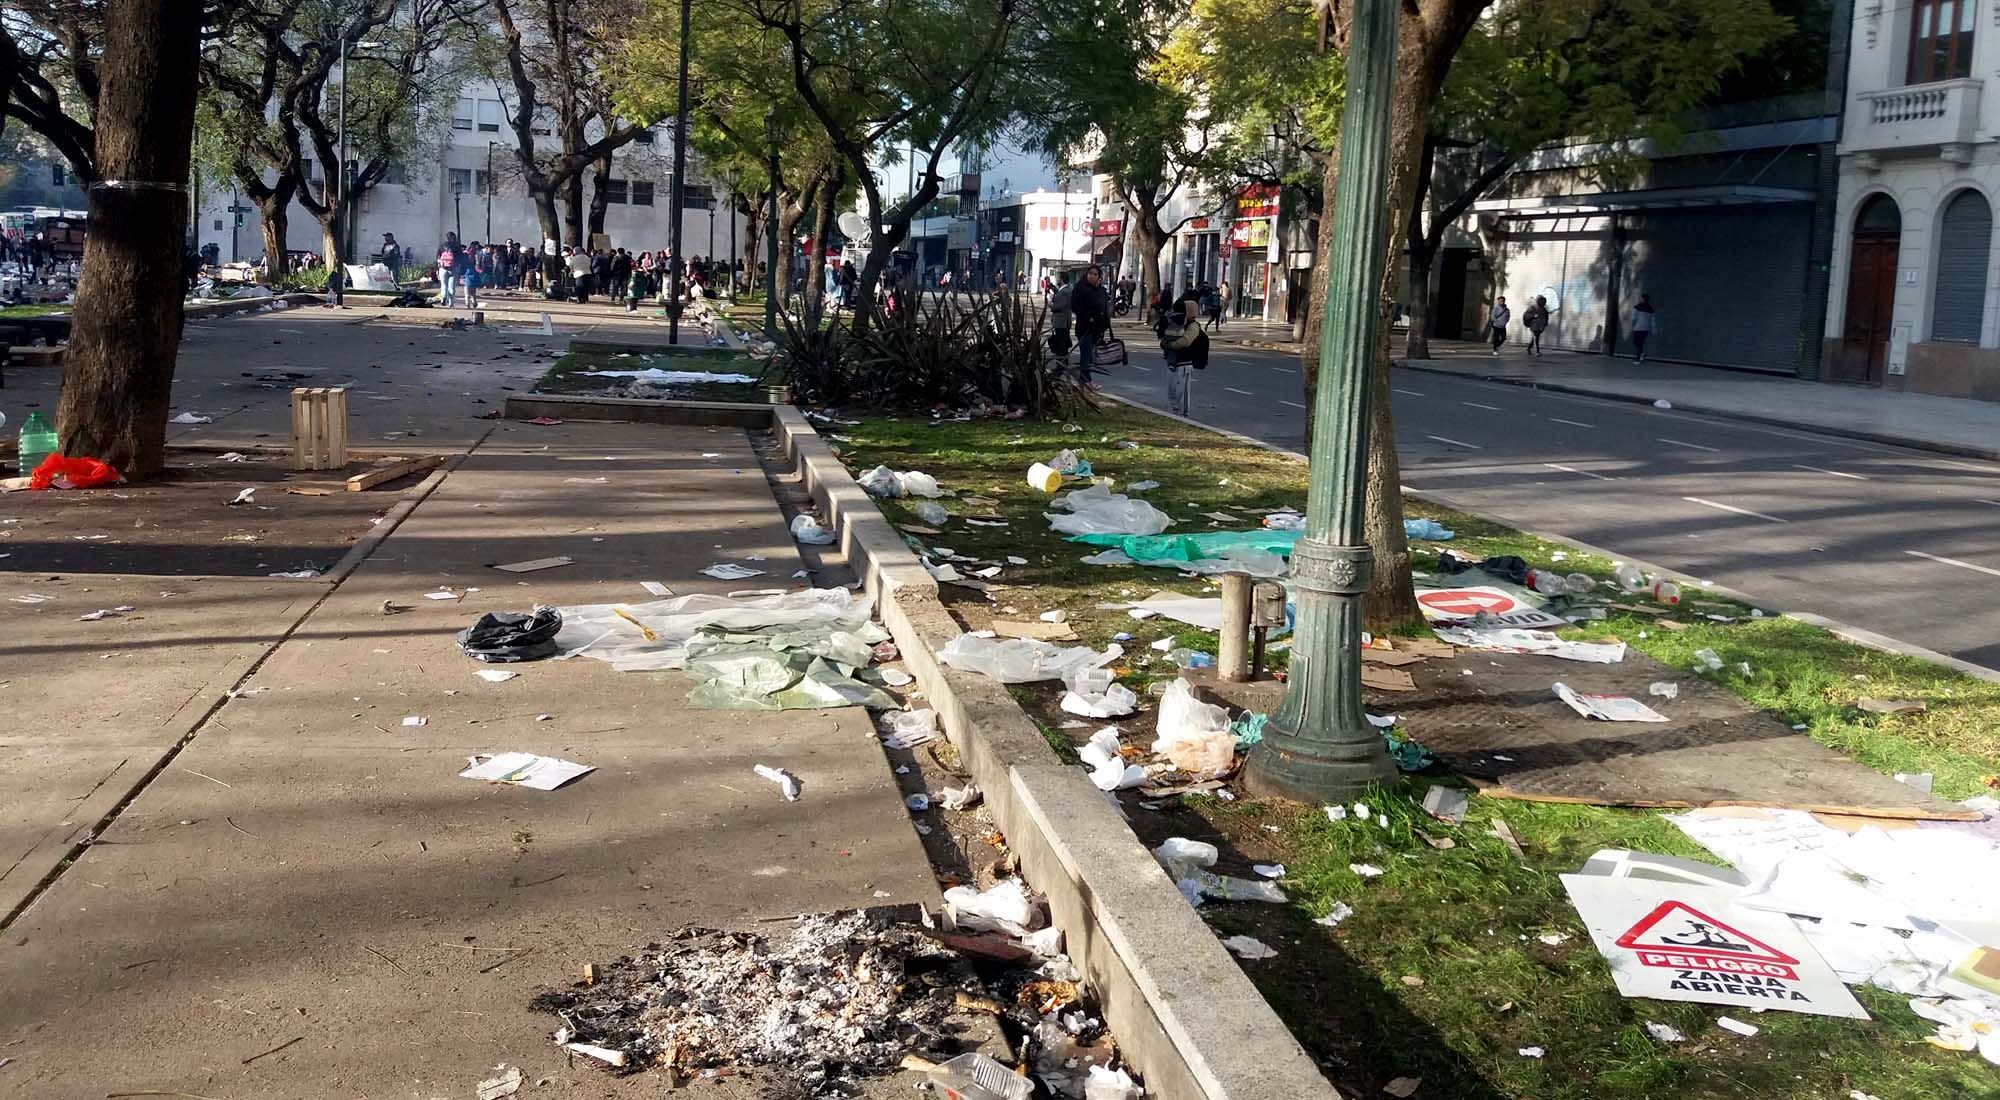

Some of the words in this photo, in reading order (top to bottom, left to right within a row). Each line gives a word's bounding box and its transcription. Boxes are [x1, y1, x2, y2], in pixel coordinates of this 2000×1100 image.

[1646, 953, 1788, 976] PELIGRO
[1674, 970, 1787, 989] ZANJA
[1670, 980, 1812, 1003] ABIERTA
